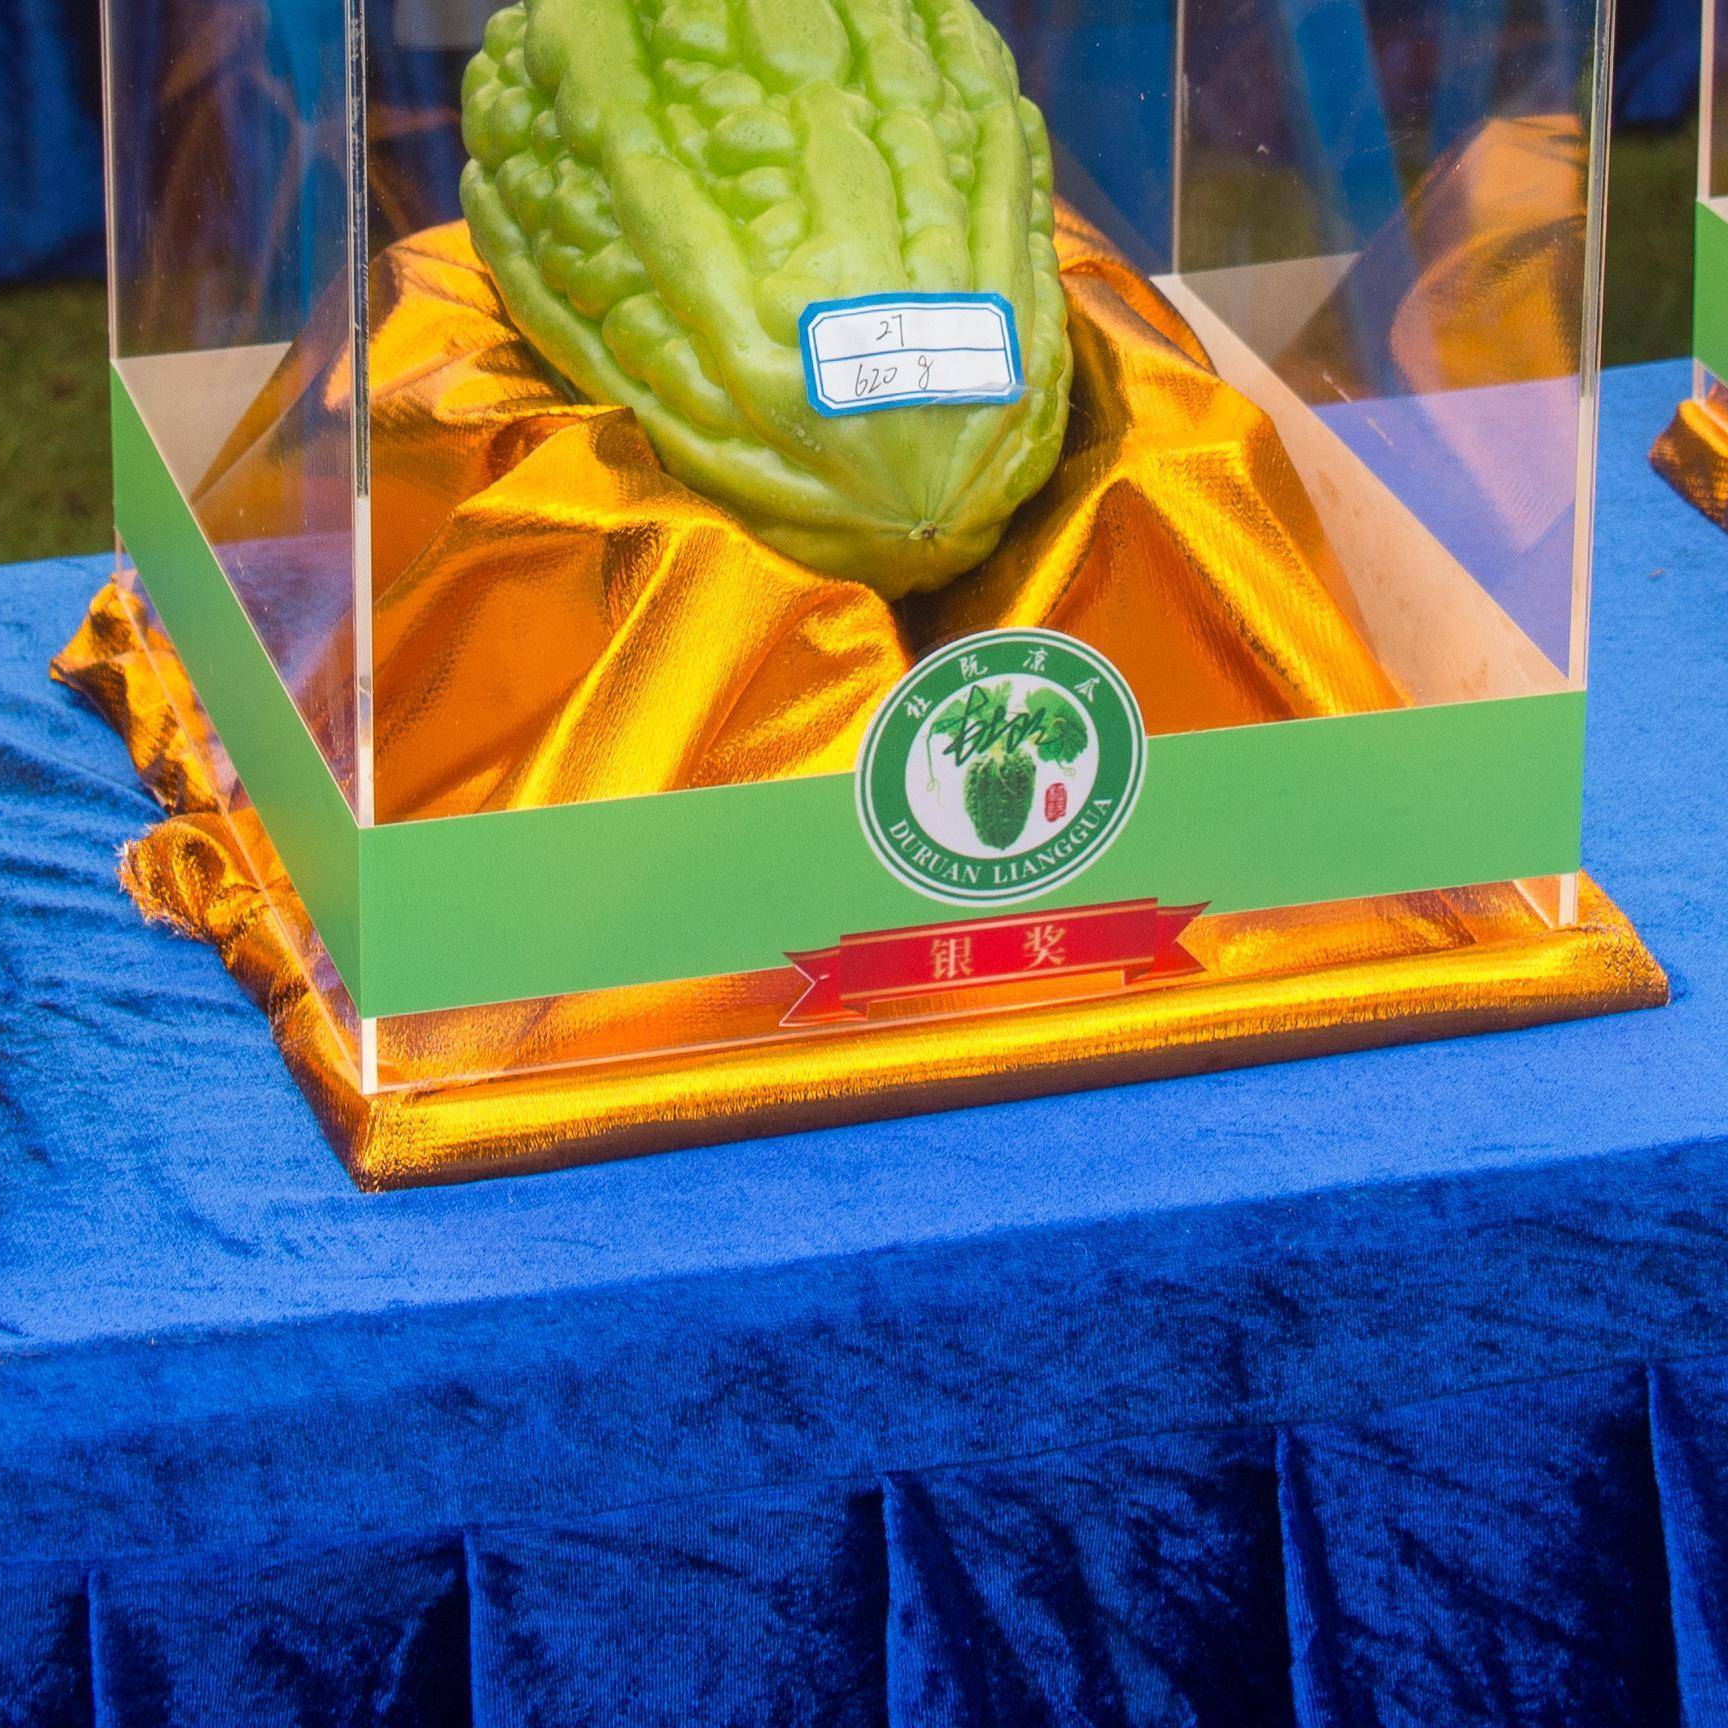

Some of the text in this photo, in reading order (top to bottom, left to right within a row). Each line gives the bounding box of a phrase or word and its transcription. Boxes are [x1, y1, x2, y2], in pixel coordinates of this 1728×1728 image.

[876, 314, 904, 347] 27
[889, 820, 982, 884] DURUAN
[992, 798, 1113, 884] LIANGGUA
[930, 925, 1066, 979] 银奖
